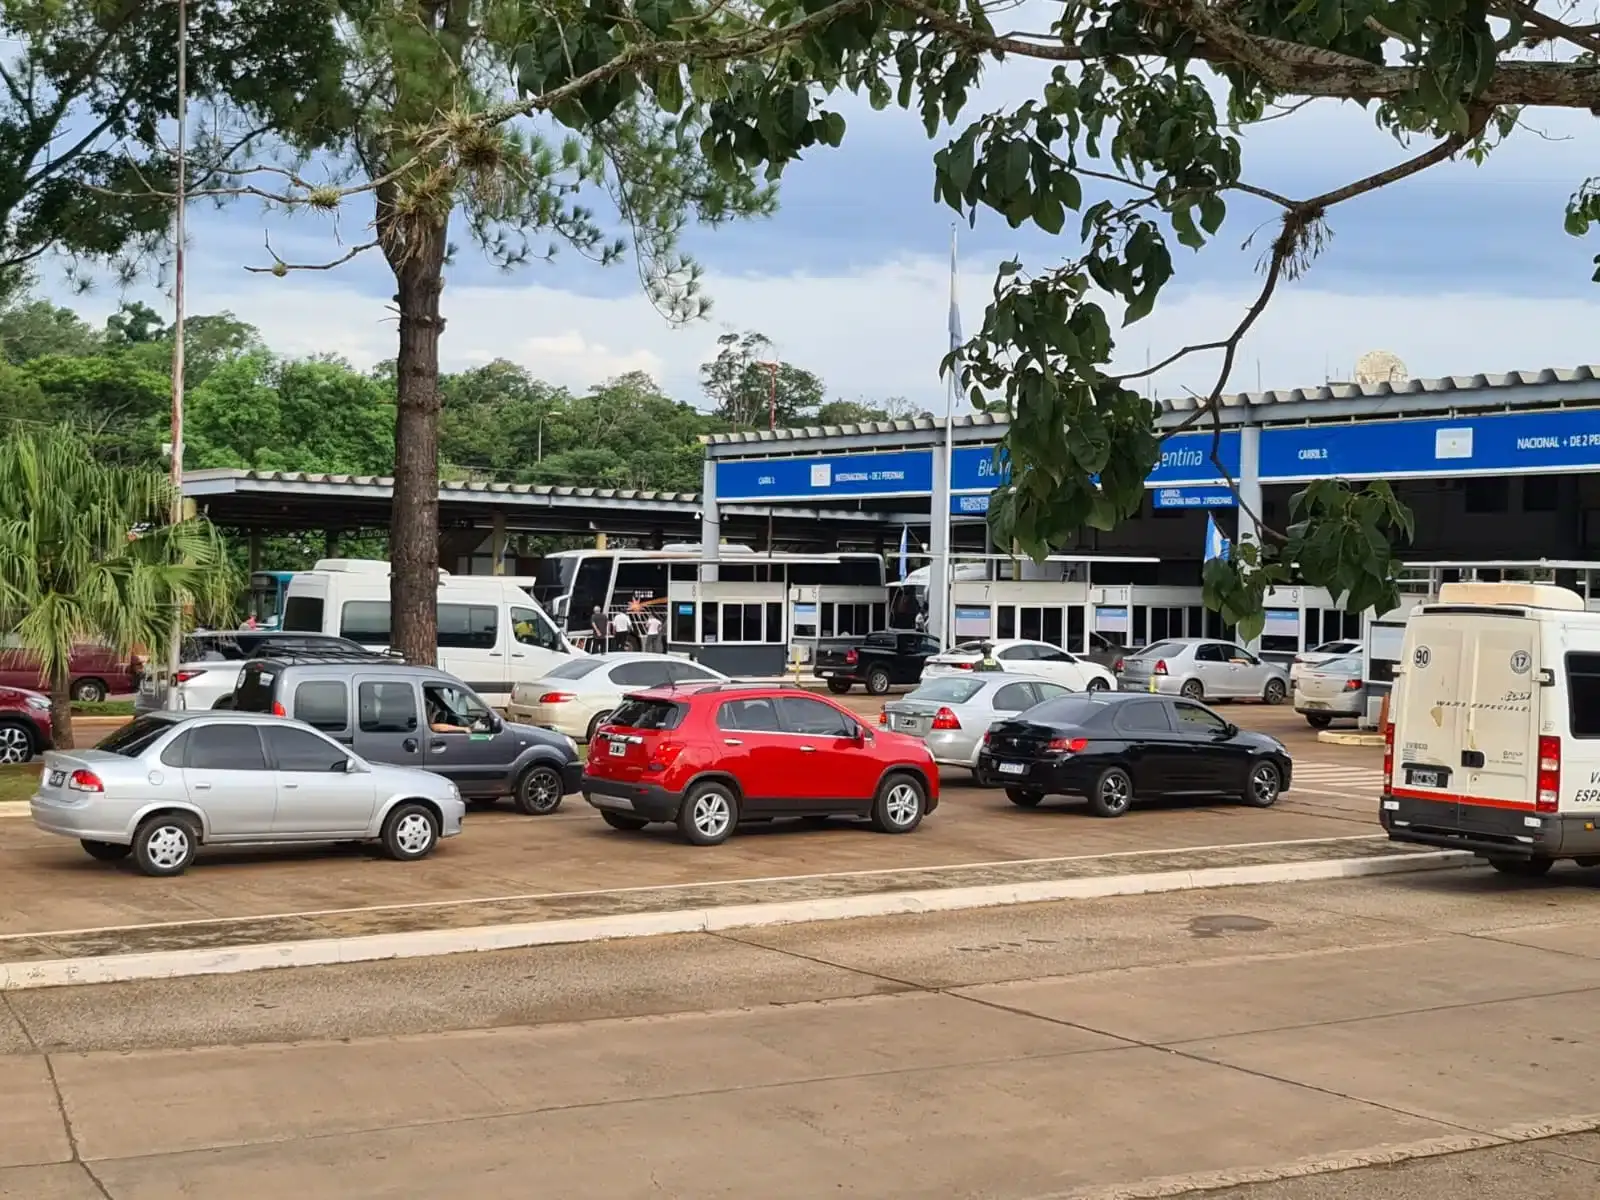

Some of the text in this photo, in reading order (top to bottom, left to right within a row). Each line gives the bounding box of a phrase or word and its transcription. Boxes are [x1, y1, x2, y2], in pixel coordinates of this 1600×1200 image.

[1517, 436, 1560, 450] NACIONAL
[1570, 434, 1581, 448] DE
[1582, 434, 1588, 447] 2
[984, 585, 990, 600] 7
[1292, 590, 1298, 603] 9
[1415, 650, 1429, 665] 90
[1515, 657, 1526, 667] 17
